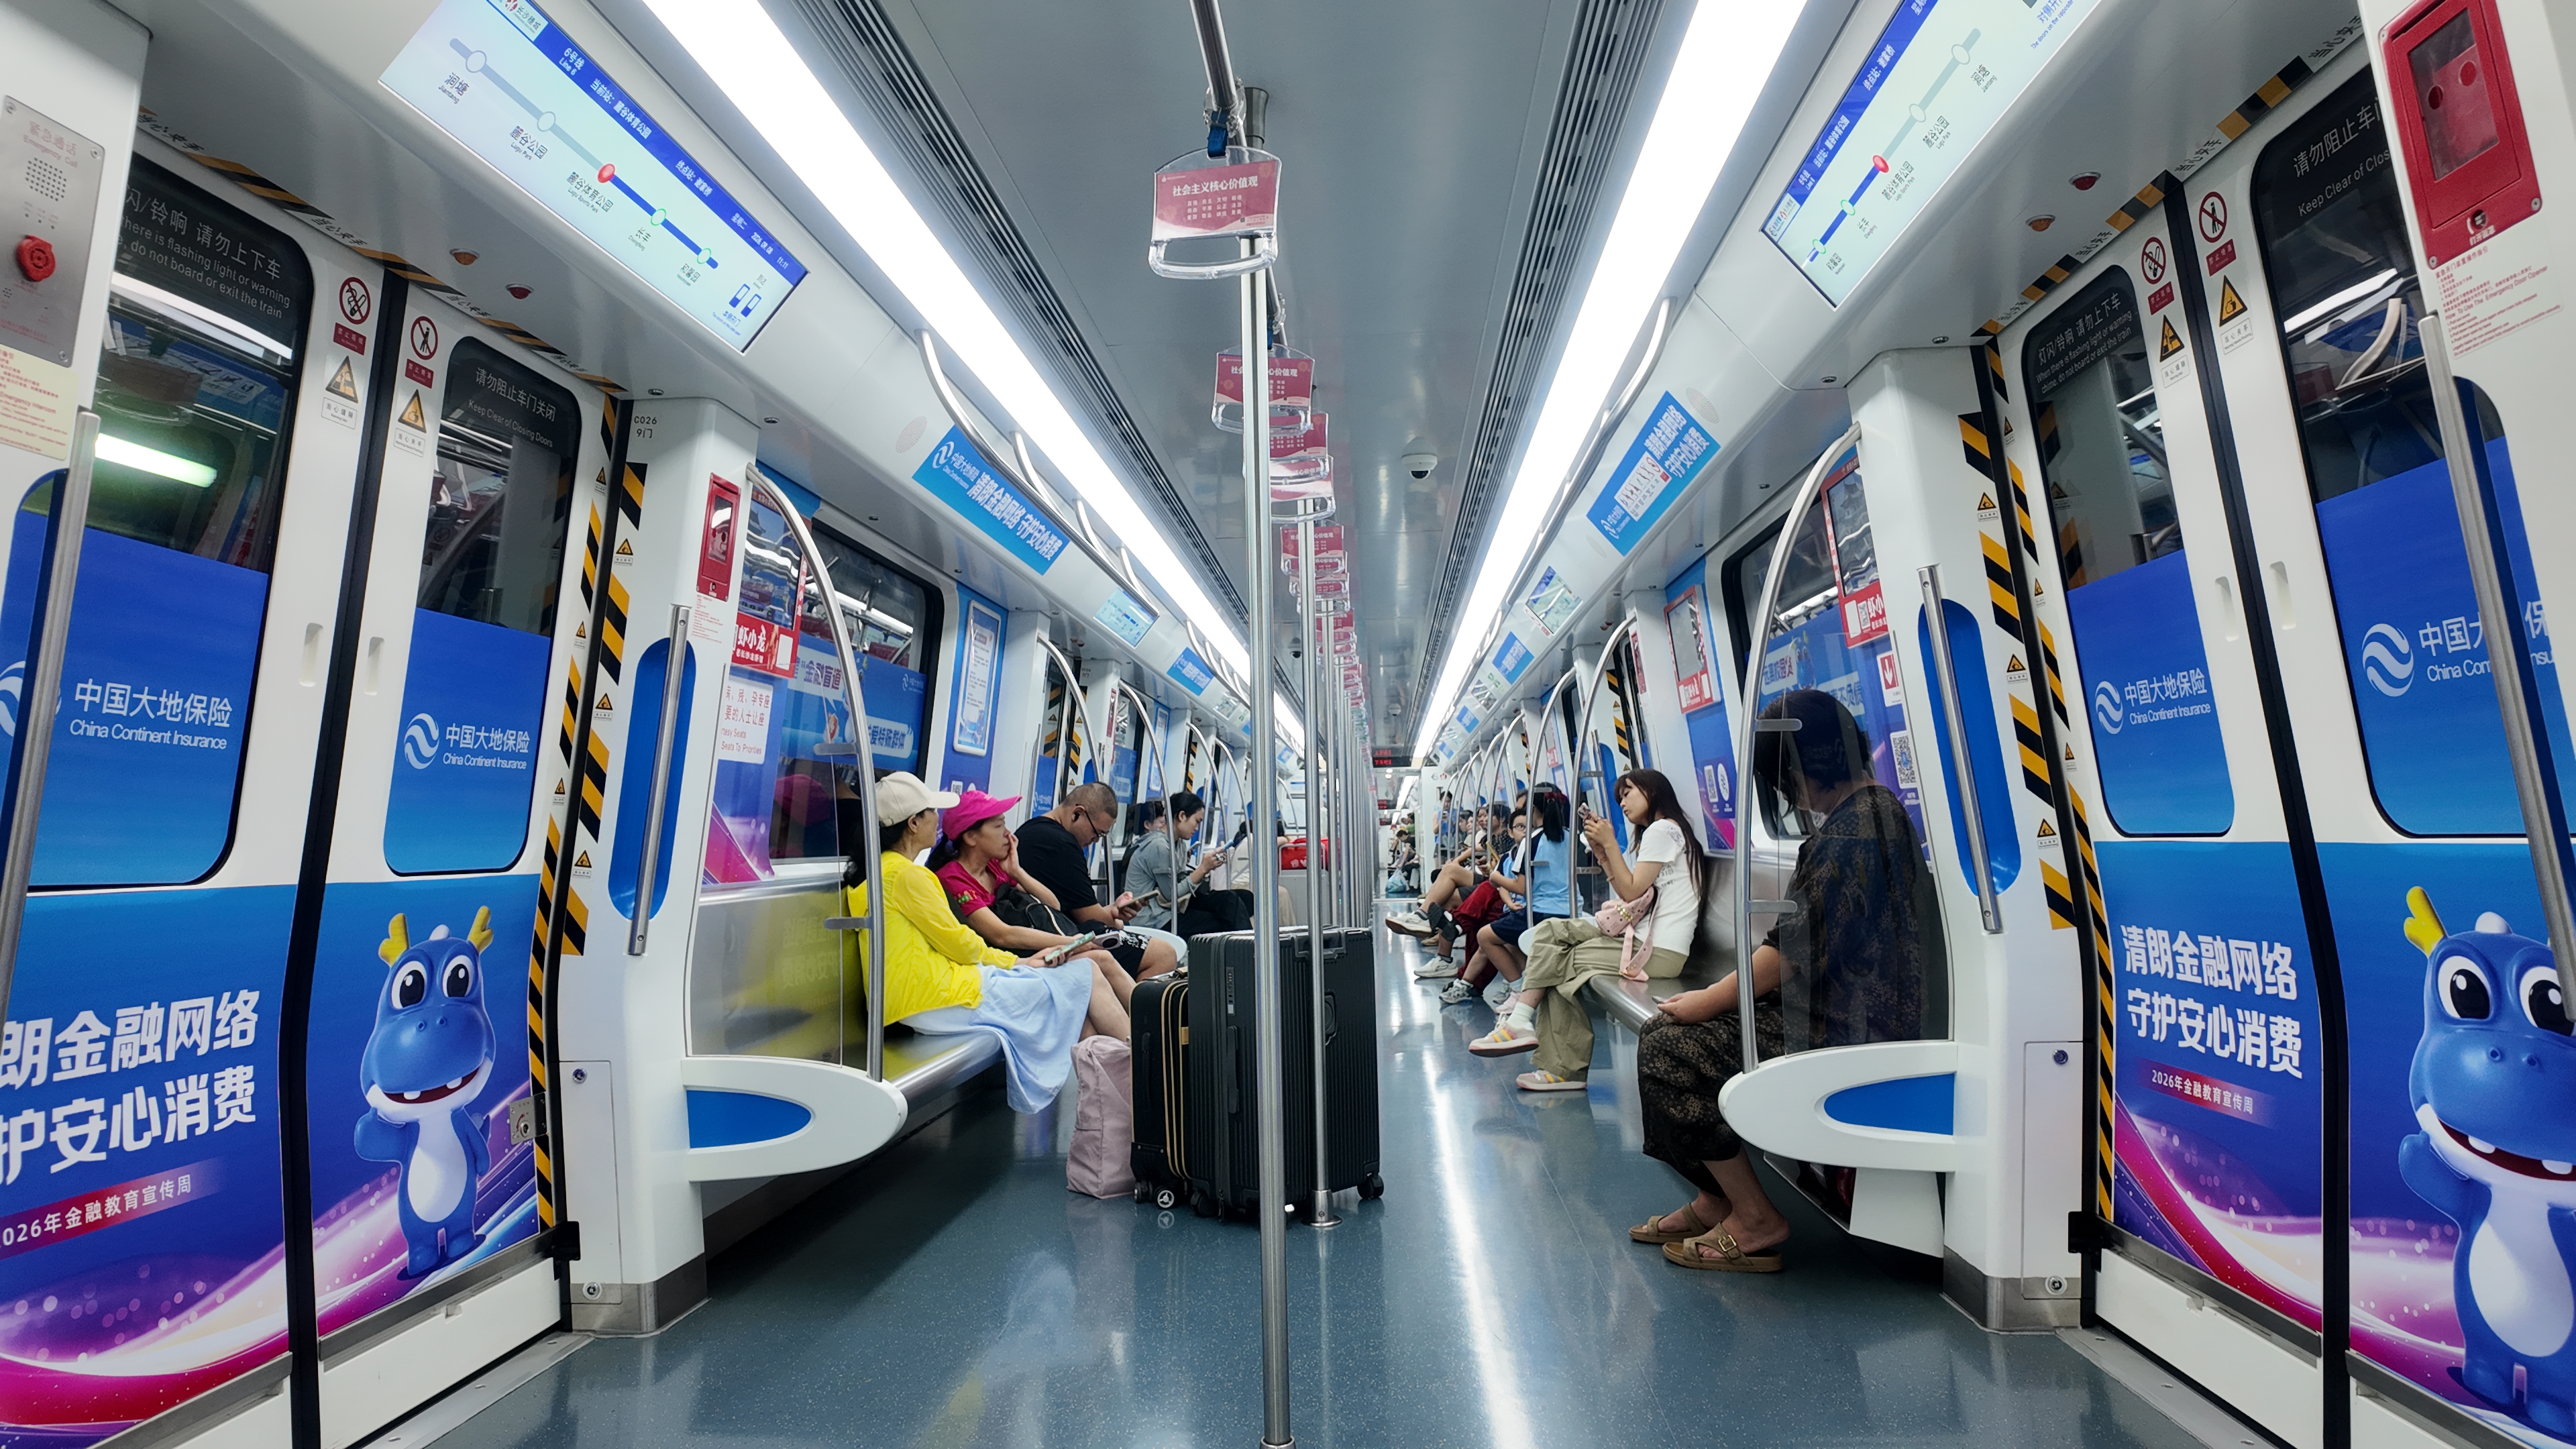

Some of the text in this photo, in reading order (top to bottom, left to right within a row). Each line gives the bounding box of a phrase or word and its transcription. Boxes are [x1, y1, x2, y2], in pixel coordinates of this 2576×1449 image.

[2031, 41, 2039, 49] The
[2037, 30, 2049, 42] doors
[559, 57, 571, 72] Line
[564, 48, 585, 70] 6号线
[438, 85, 460, 105] Jiantang
[1982, 74, 1998, 93] Jiantang
[23, 135, 61, 160] Emergency
[509, 125, 548, 160] 麓谷公园
[1923, 115, 1949, 148] 麓谷公园
[1935, 131, 1951, 149] Lugu Park
[511, 142, 532, 160] Lugu Park
[566, 172, 613, 212] 麓谷体育公园
[1173, 175, 1258, 197] 社会主义核心价值观
[1882, 161, 1915, 201] 麓谷体育公园
[2298, 195, 2324, 217] Keep
[2325, 174, 2352, 199] Clear
[2354, 163, 2365, 180] of
[197, 222, 281, 280] 请勿上下车
[131, 240, 146, 256] do
[150, 251, 168, 266] not
[170, 257, 204, 282] board
[205, 276, 218, 288] or
[219, 281, 239, 299] exit
[241, 290, 258, 309] the
[260, 302, 282, 319] train
[155, 231, 165, 246] is
[168, 236, 212, 270] flashing
[213, 259, 237, 282] light
[238, 274, 251, 286] or
[251, 280, 291, 309] warning
[2485, 282, 2514, 301] Emergency
[2076, 292, 2121, 337] 请勿上下车
[2036, 311, 2132, 383] When there is flashing light or warning
[2058, 372, 2065, 382] do
[2065, 366, 2075, 378] not
[2074, 353, 2090, 372] board
[2090, 349, 2096, 360] or
[2097, 343, 2108, 356] exit
[2108, 335, 2117, 349] the
[2118, 326, 2132, 343] train
[476, 367, 556, 422] 请勿阻止车门关闭
[468, 399, 553, 448] Keep Clear of Closing Doors
[636, 428, 653, 438] 9门
[1644, 405, 1688, 460] 清朗金融网络
[951, 453, 979, 482] 中国大地保险
[1664, 427, 1710, 478] 守护安心消费
[967, 472, 1063, 561] 清朗金融网络 守护安心消费
[2125, 668, 2208, 707] 中国大地保险
[2427, 662, 2462, 682] China
[74, 678, 233, 728] 中国大地保险
[2130, 702, 2211, 724] China Continent Insurance
[70, 719, 227, 750] China Continent Insurance
[445, 722, 530, 753] 中国大地保险
[721, 741, 762, 755] Seats To Priorities
[734, 728, 746, 739] Seats
[443, 752, 527, 769] China Continent Insurance
[2121, 924, 2297, 1000] 清朗金融网络
[2127, 987, 2302, 1079] 守护安心消费
[2151, 1069, 2253, 1115] 2026年金融教育宣传周
